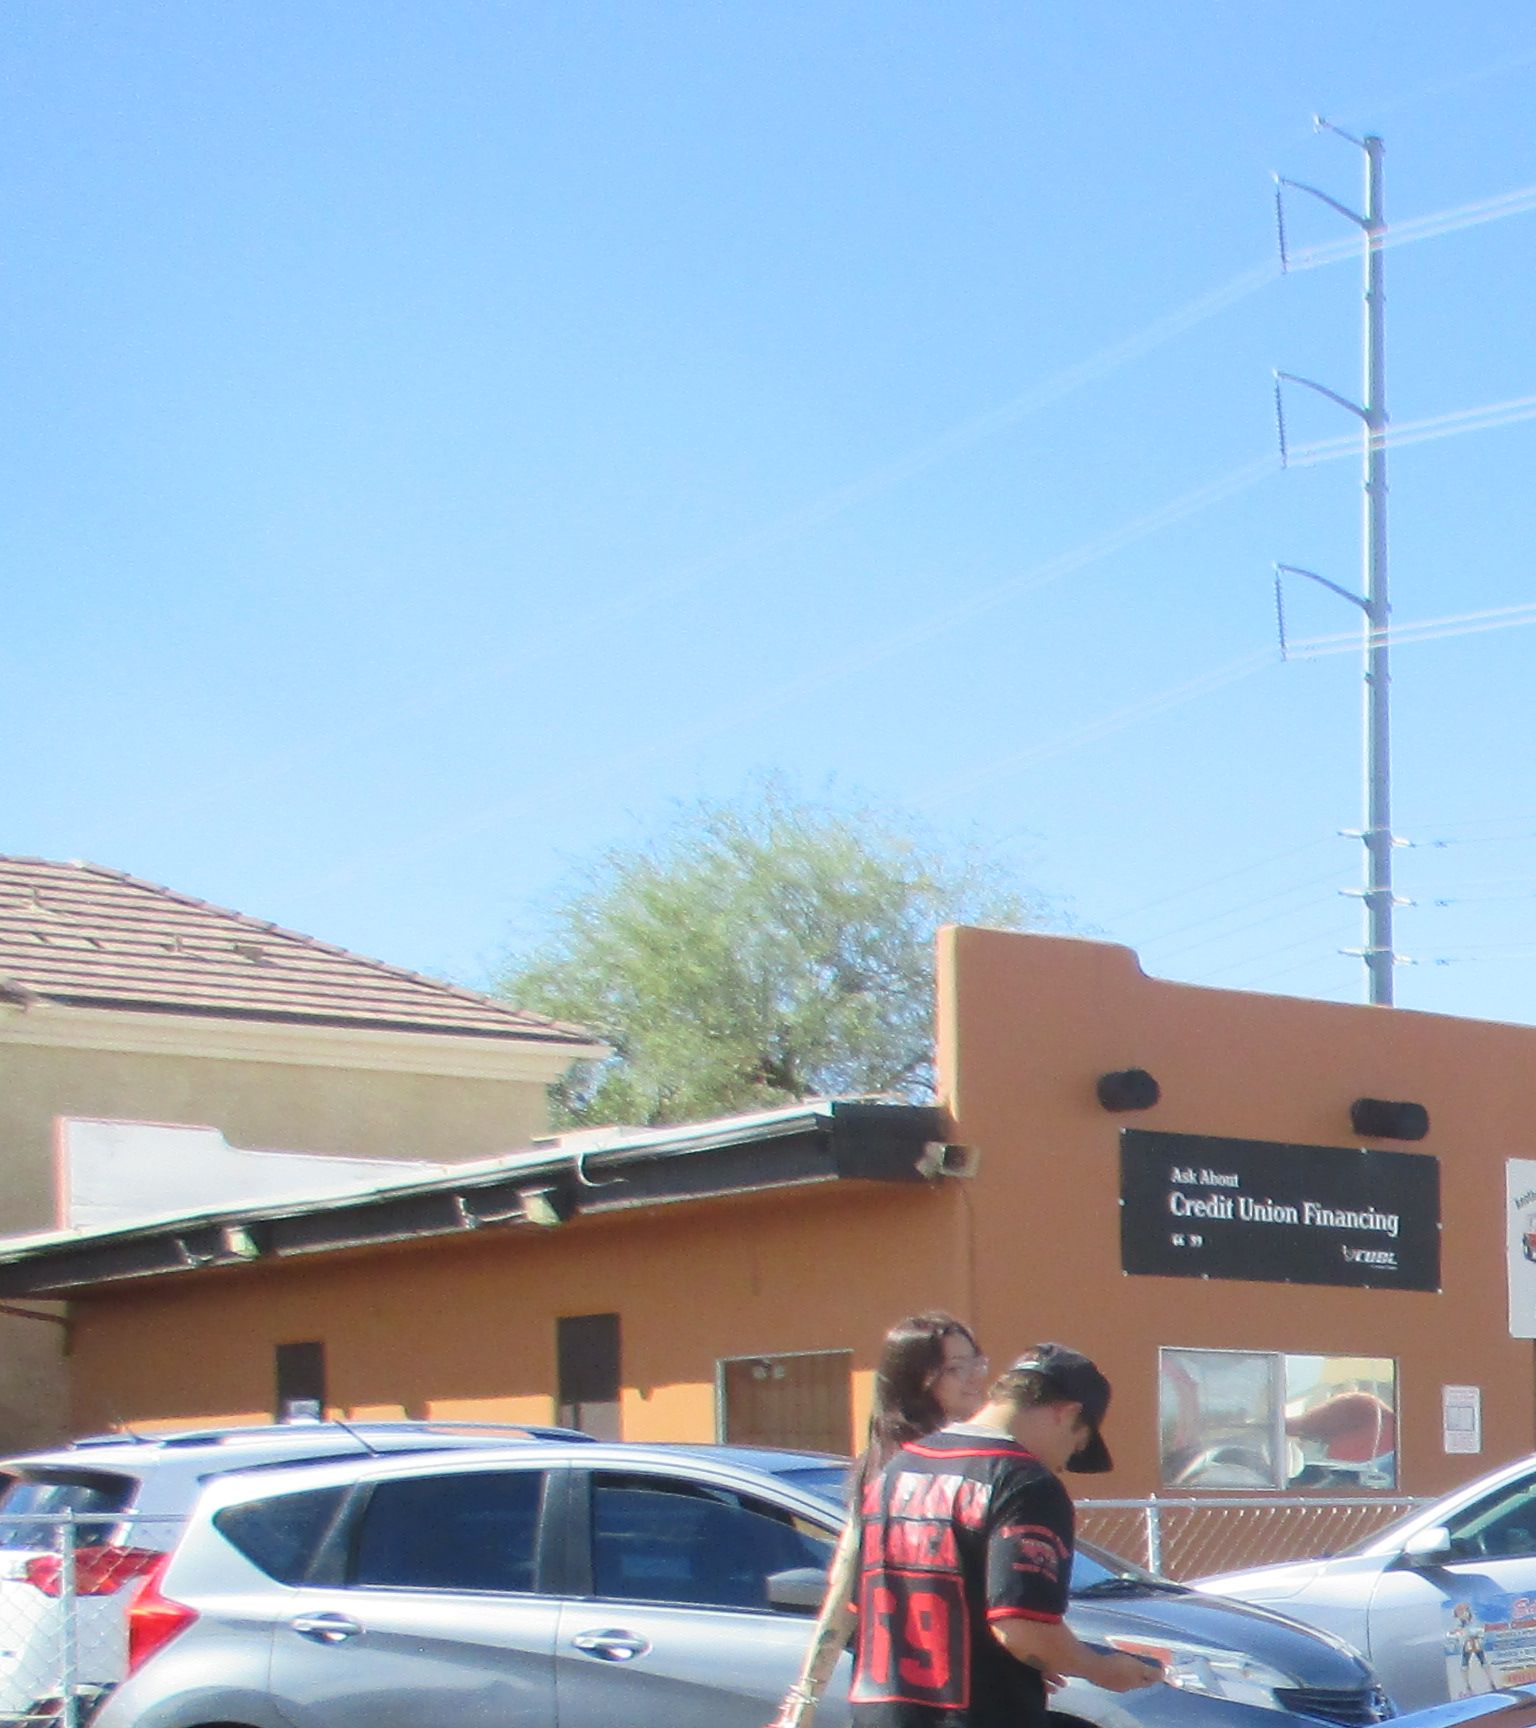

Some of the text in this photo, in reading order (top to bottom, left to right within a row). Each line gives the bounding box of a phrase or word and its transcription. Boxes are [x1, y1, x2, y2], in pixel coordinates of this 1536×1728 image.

[1171, 1167, 1239, 1188] Ask About
[1169, 1191, 1399, 1237] Credit Union Financing
